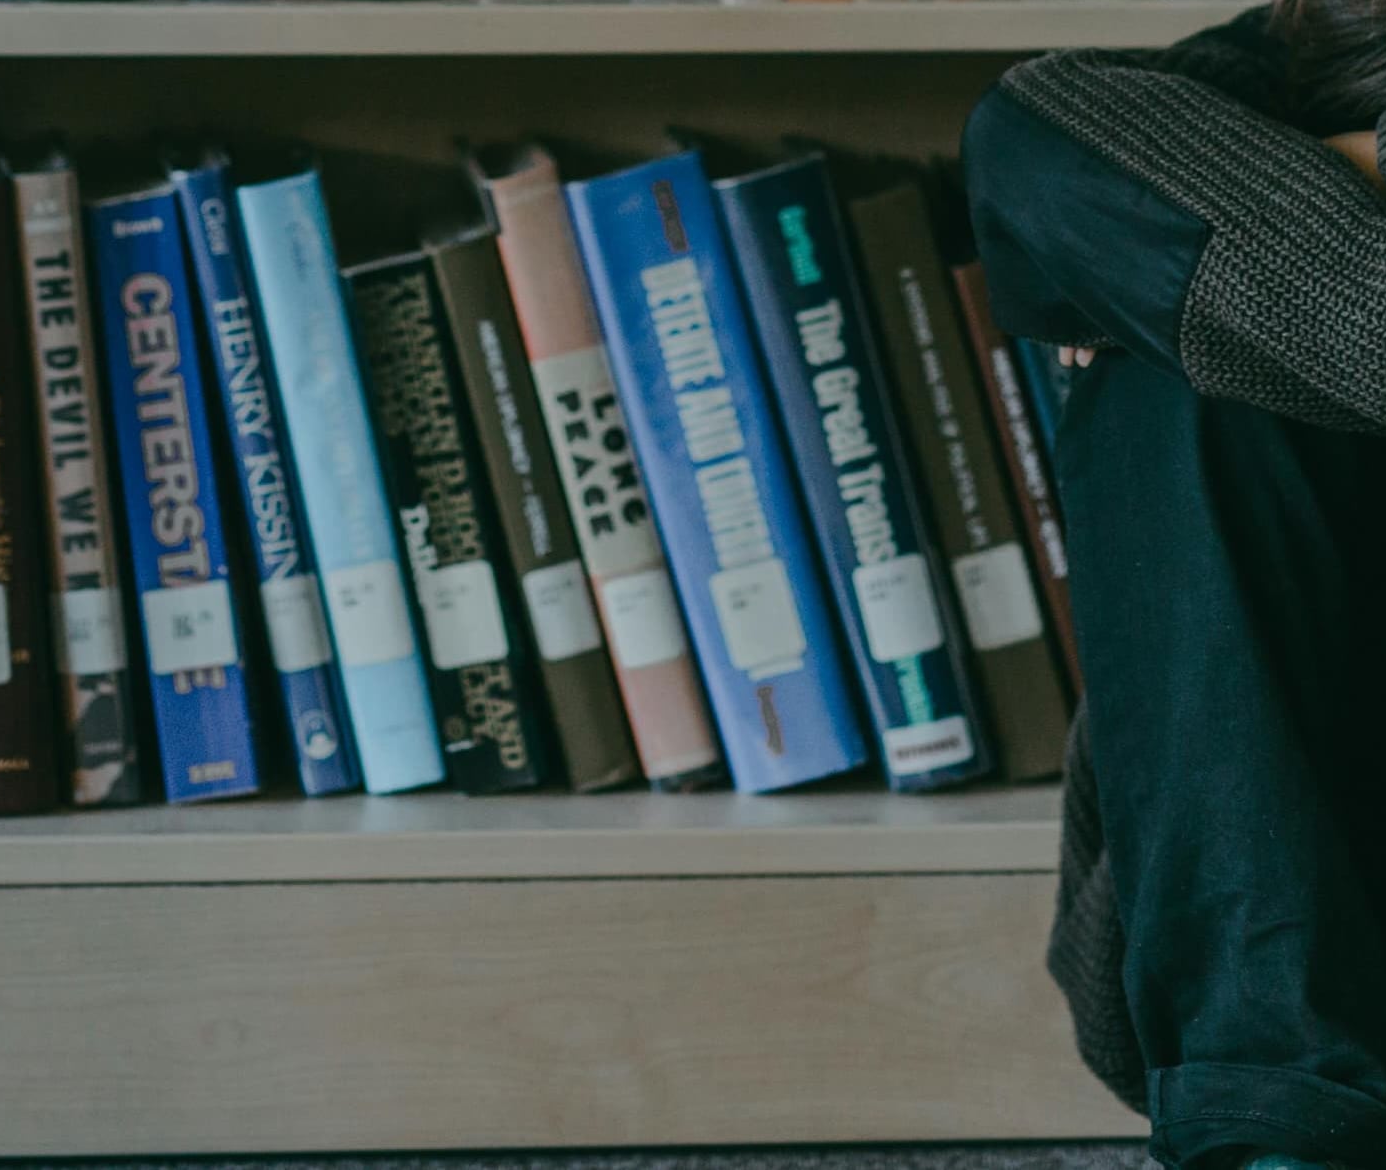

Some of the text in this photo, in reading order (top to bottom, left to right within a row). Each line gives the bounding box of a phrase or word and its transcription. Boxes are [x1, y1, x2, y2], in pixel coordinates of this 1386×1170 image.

[34, 249, 98, 554] THE DEVIL WE
[212, 296, 274, 439] HENRY
[243, 450, 301, 582] KISSIN
[399, 272, 465, 453] FRANKLIN
[675, 386, 744, 463] AND
[795, 298, 879, 465] The Great
[555, 389, 616, 538] PEACE
[593, 391, 648, 527] LONG
